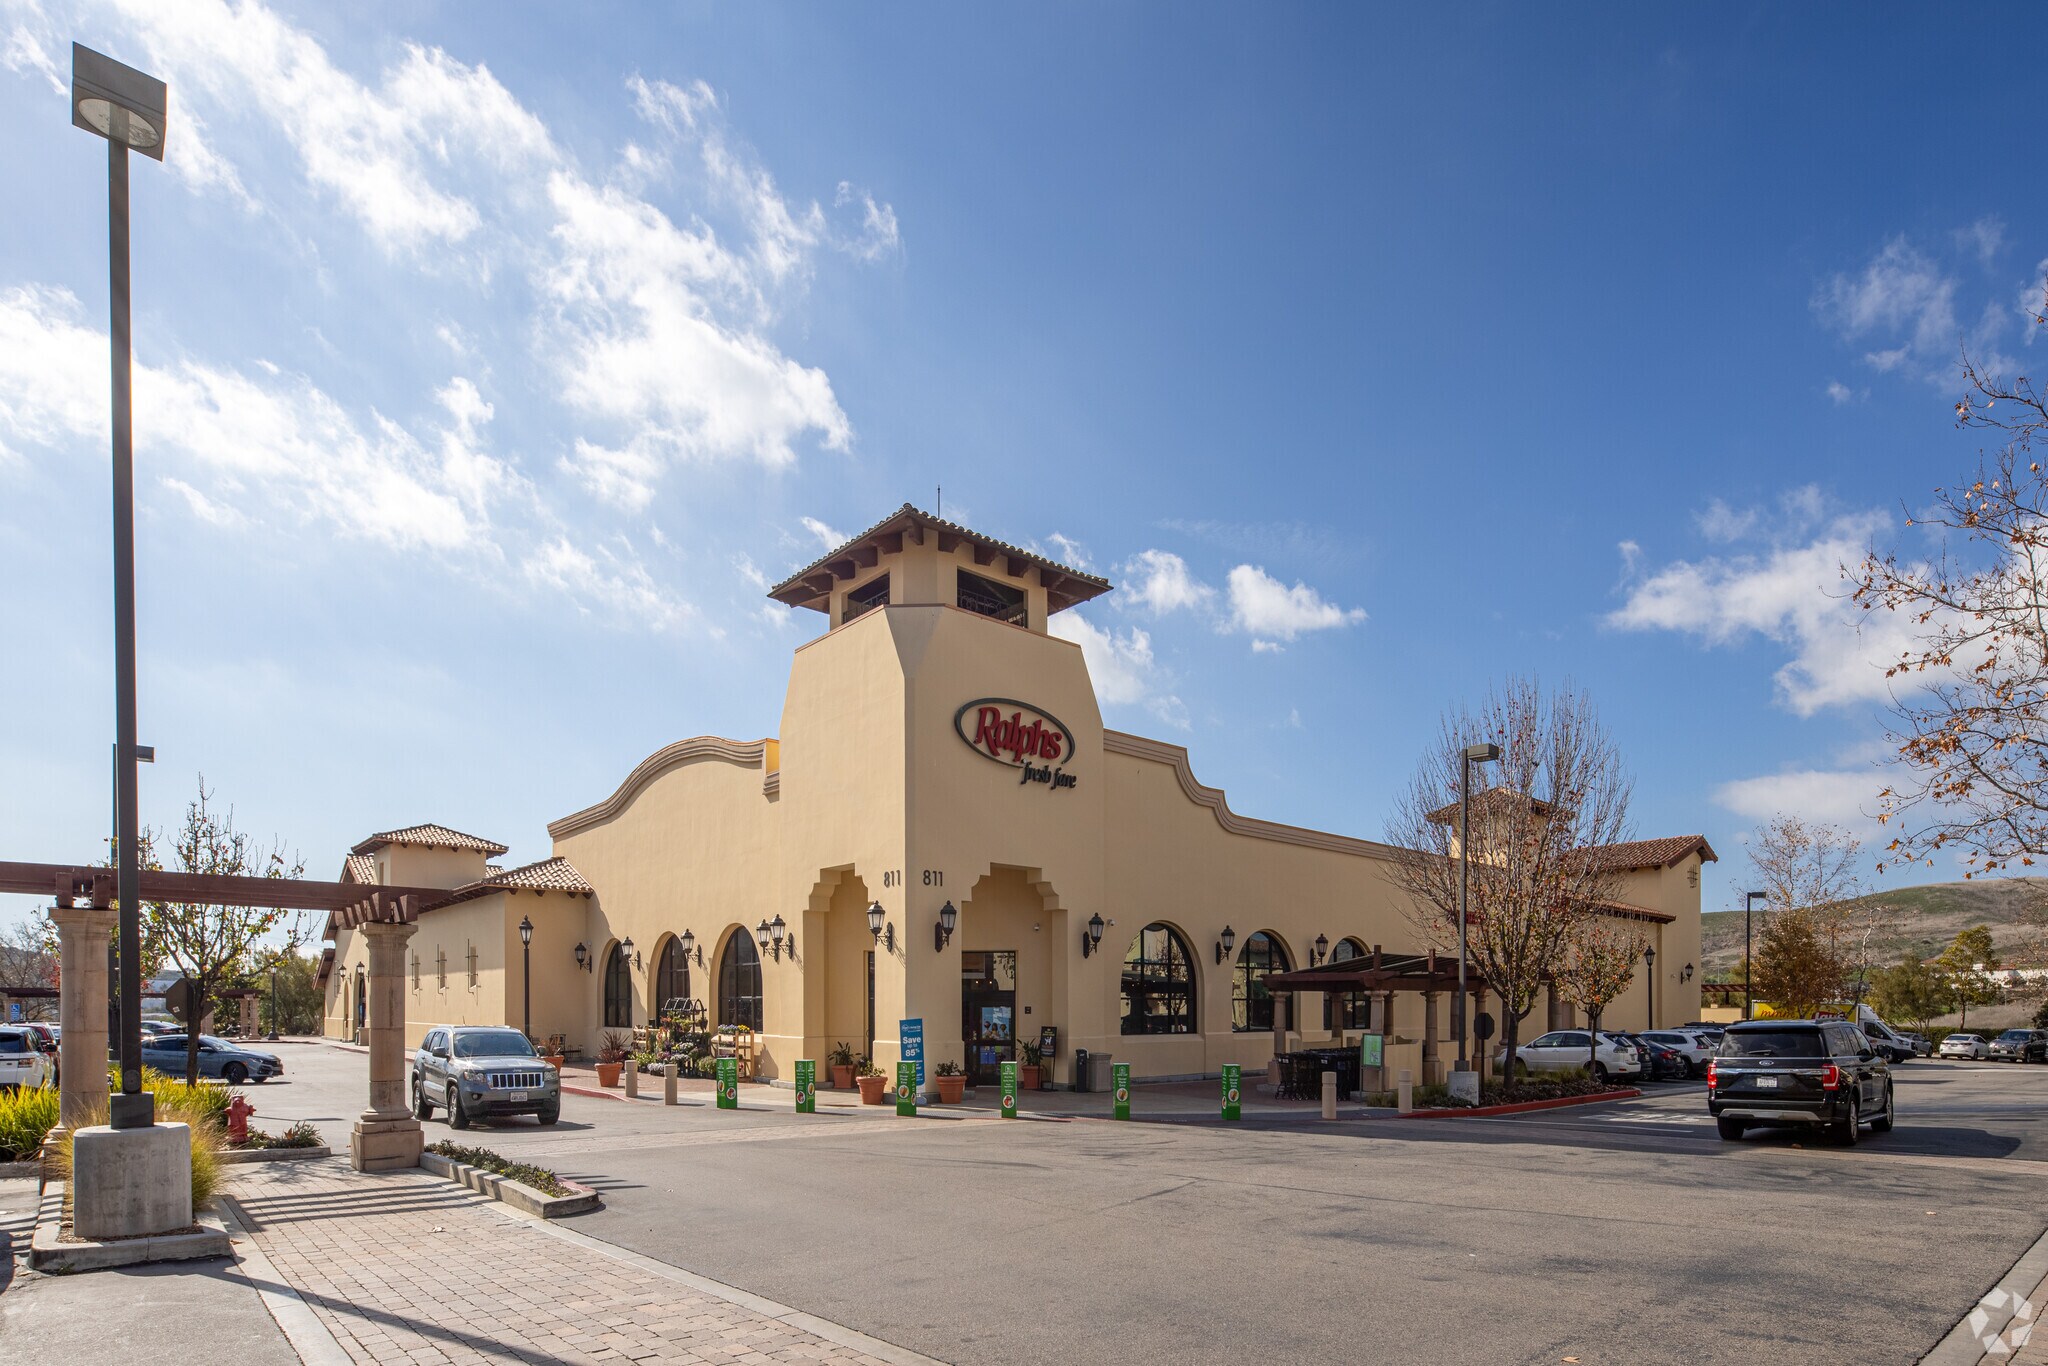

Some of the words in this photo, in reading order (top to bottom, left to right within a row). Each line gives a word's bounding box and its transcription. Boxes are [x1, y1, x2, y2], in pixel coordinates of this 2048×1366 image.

[974, 706, 1063, 763] Ralphs
[1020, 761, 1052, 784] fresh
[1050, 767, 1077, 790] fare
[884, 869, 901, 888] 811
[923, 869, 943, 887] 811
[902, 1036, 922, 1045] Save
